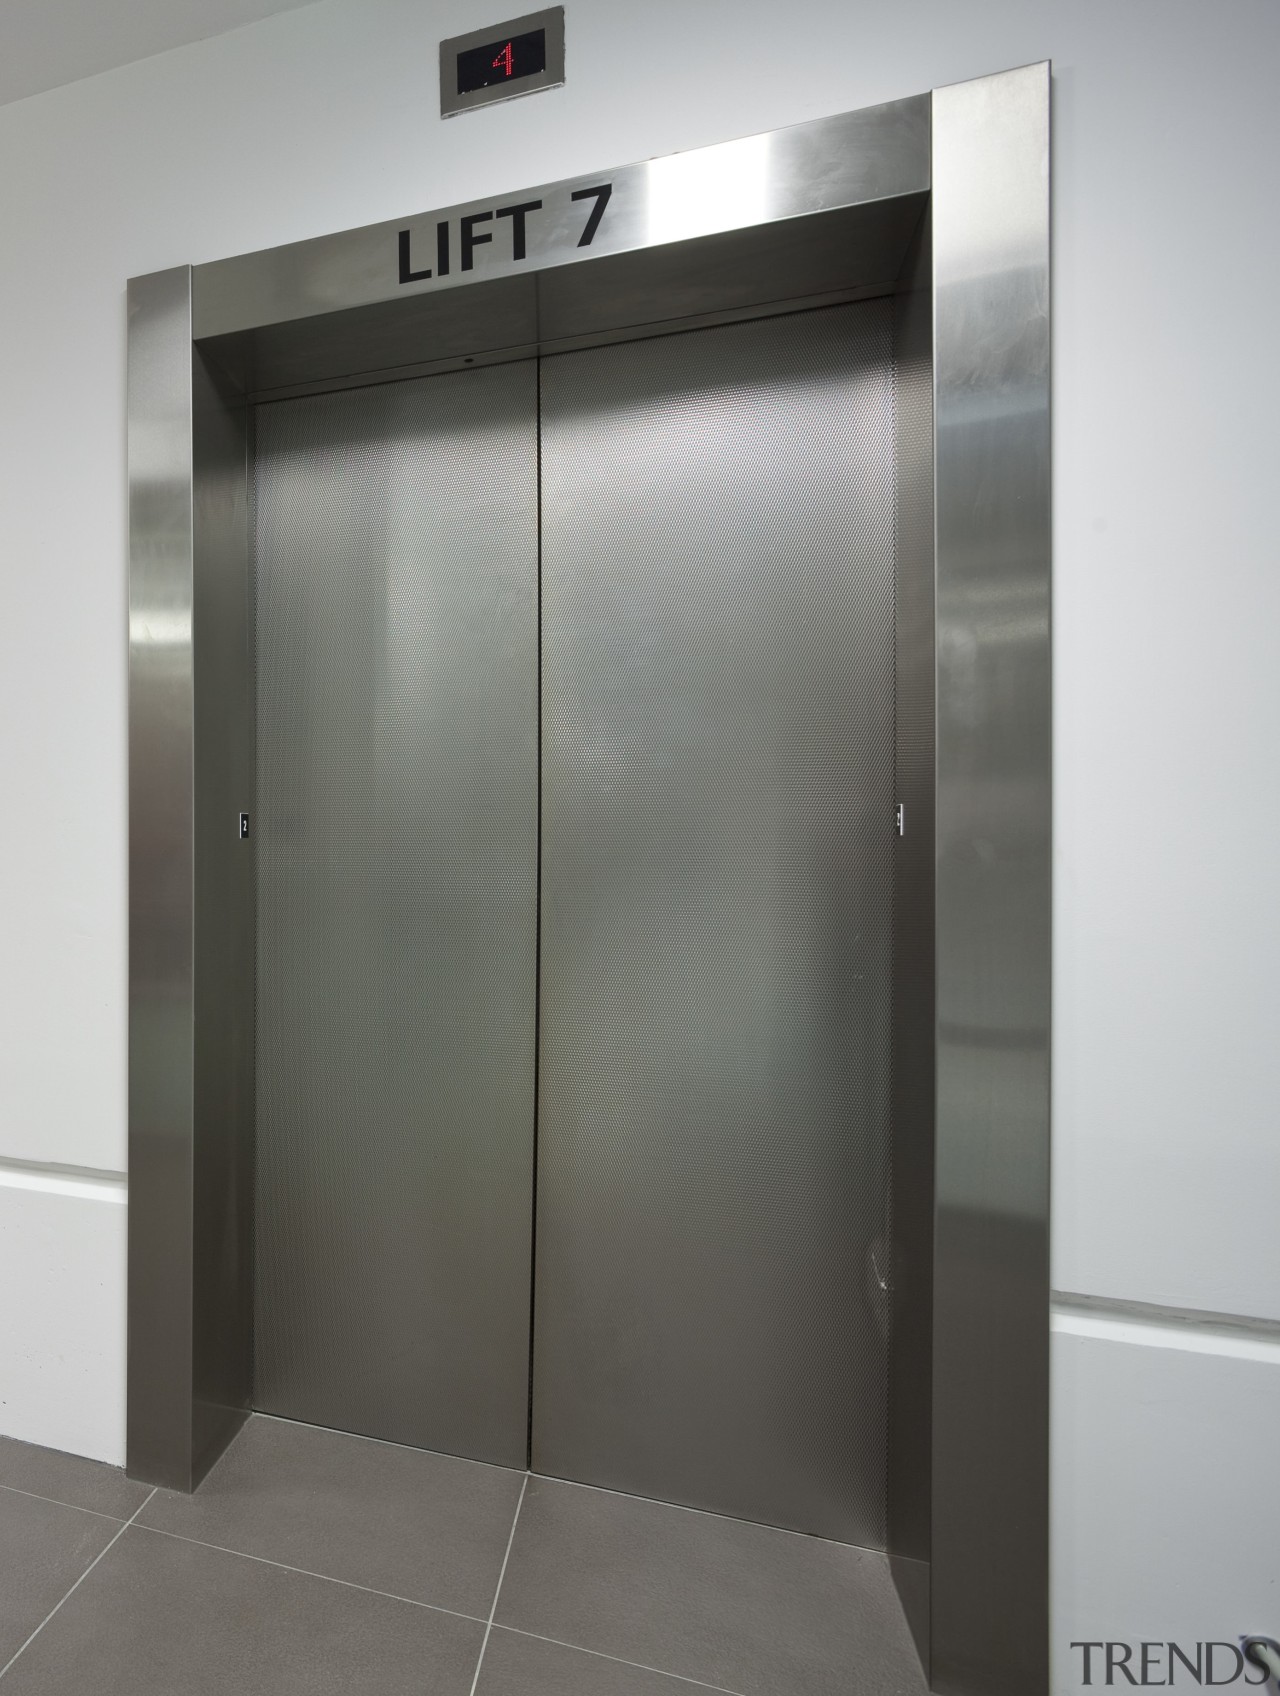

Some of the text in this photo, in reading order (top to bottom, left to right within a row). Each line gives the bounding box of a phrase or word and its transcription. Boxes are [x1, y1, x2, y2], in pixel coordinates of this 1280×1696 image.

[492, 42, 514, 76] 4
[398, 183, 613, 285] LIFT 7
[243, 819, 248, 832] 2
